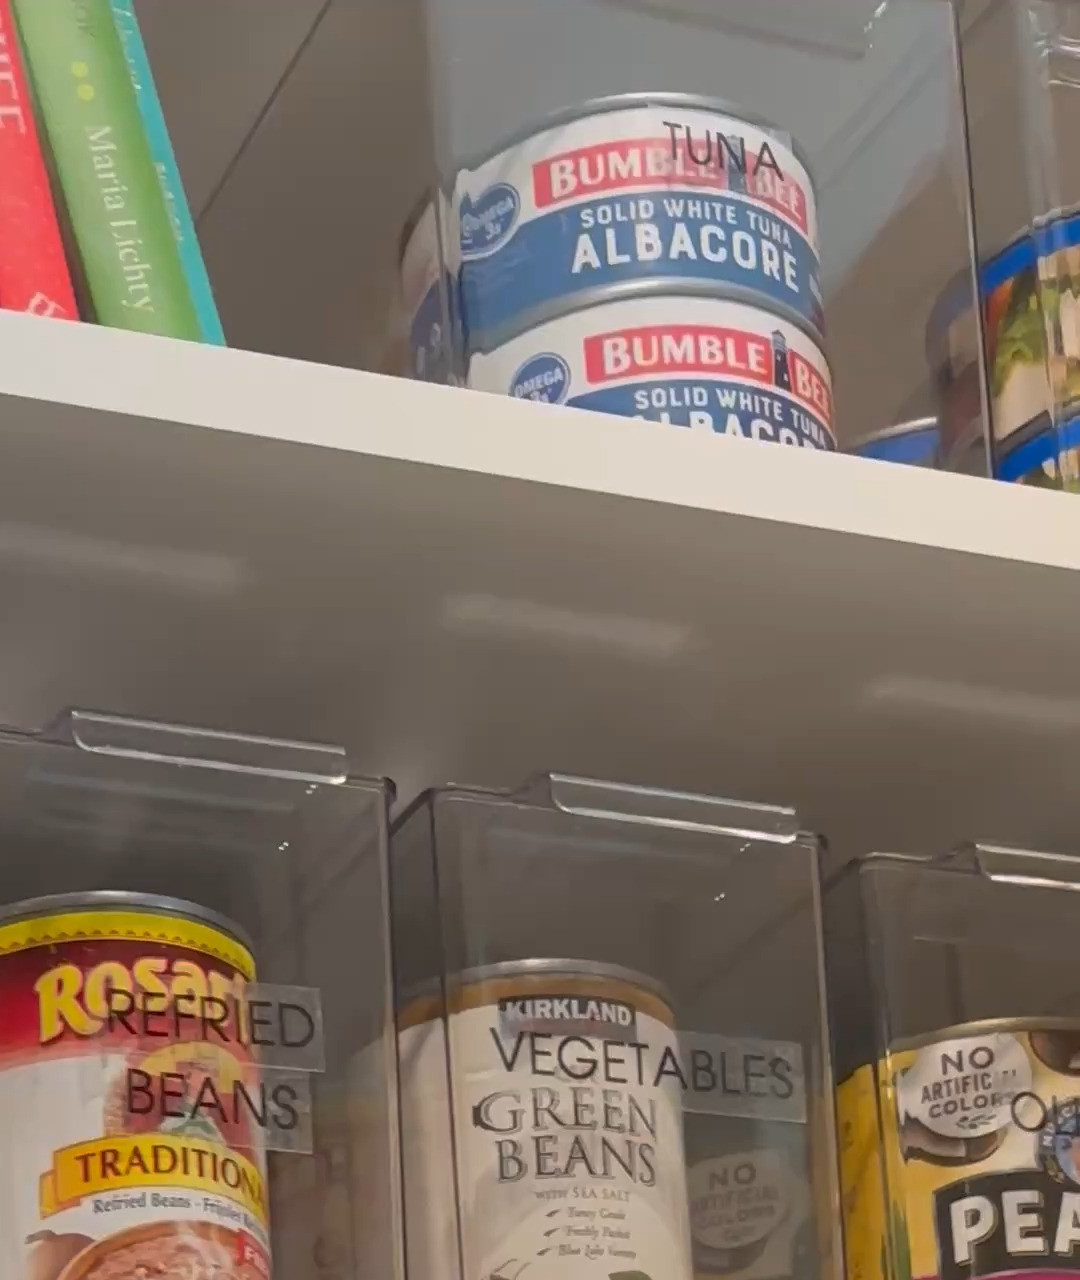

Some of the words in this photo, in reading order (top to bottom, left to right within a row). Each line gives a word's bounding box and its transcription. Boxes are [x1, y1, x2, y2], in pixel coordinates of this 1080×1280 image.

[549, 145, 719, 200] BUMBLE
[663, 121, 785, 181] TUNA
[84, 125, 129, 212] Maria
[109, 219, 156, 314] Lichty
[579, 199, 655, 230] SOLID
[664, 198, 739, 226] WHITE
[747, 211, 794, 251] TUNA
[570, 222, 801, 294] ALBACORE
[603, 333, 769, 376] BUMBLE
[633, 387, 709, 411] SOLID
[718, 387, 785, 422] WHITE
[106, 988, 316, 1049] REFRIED
[503, 997, 632, 1029] KIRKLAND
[489, 1025, 796, 1101] VEGETABLES
[940, 1046, 995, 1075] NO
[127, 1067, 302, 1131] BEANS
[472, 1086, 659, 1144] GREEN
[495, 1134, 658, 1188] BEANS
